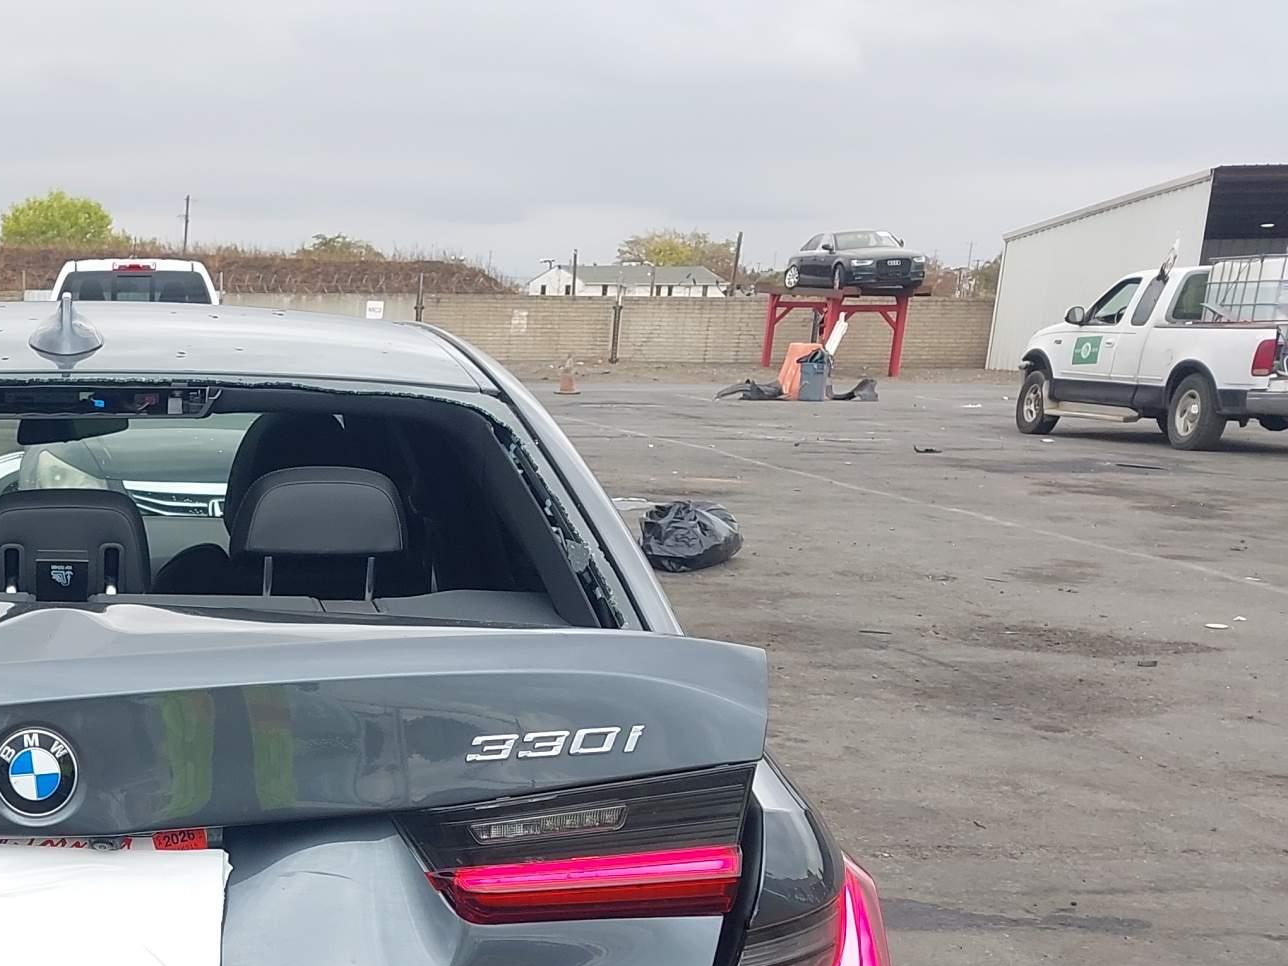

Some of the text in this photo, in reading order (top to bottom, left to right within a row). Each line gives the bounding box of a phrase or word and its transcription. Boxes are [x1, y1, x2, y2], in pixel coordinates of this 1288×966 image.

[0, 732, 69, 764] BMW
[465, 725, 646, 762] 330i
[162, 830, 196, 849] 2026
